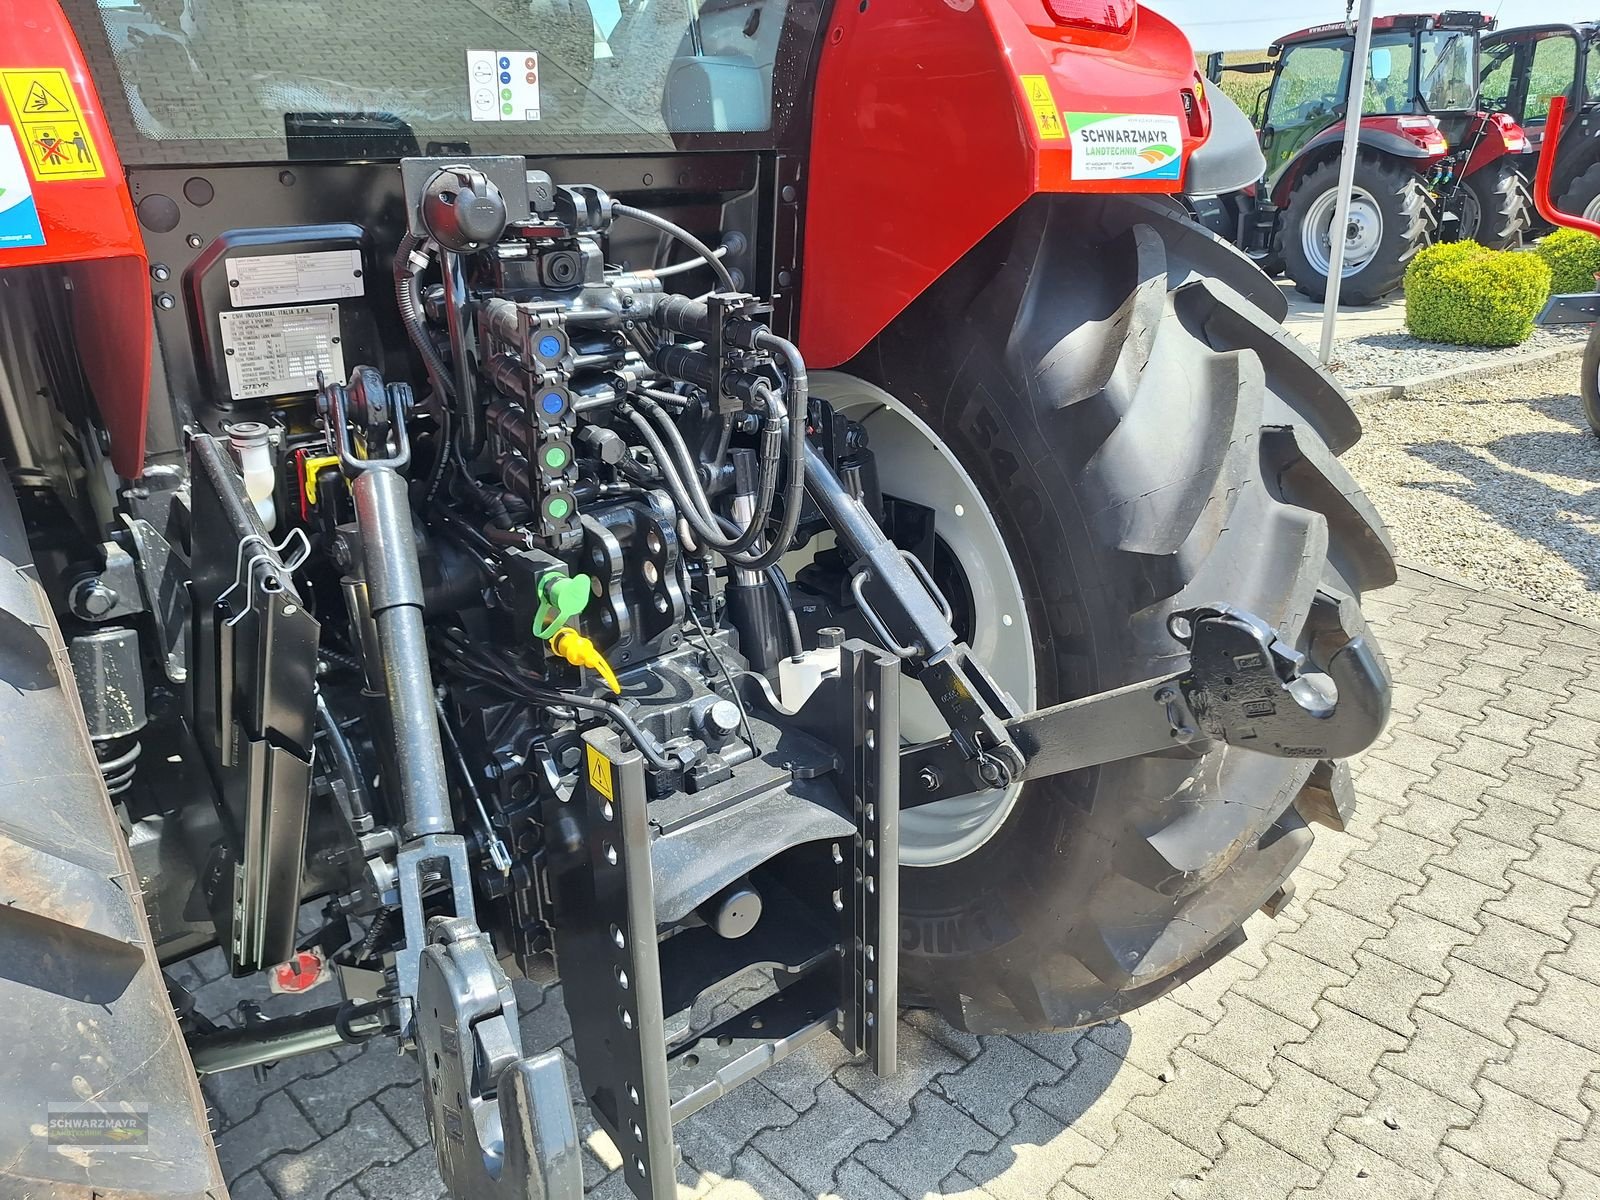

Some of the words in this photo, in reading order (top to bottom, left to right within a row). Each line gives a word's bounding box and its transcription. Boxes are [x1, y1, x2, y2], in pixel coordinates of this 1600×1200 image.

[1081, 129, 1168, 143] SCHWARZMAYR
[1085, 146, 1137, 157] LANDTECHNIK
[244, 310, 275, 318] INDUSTRIAL
[241, 382, 269, 390] STEYR
